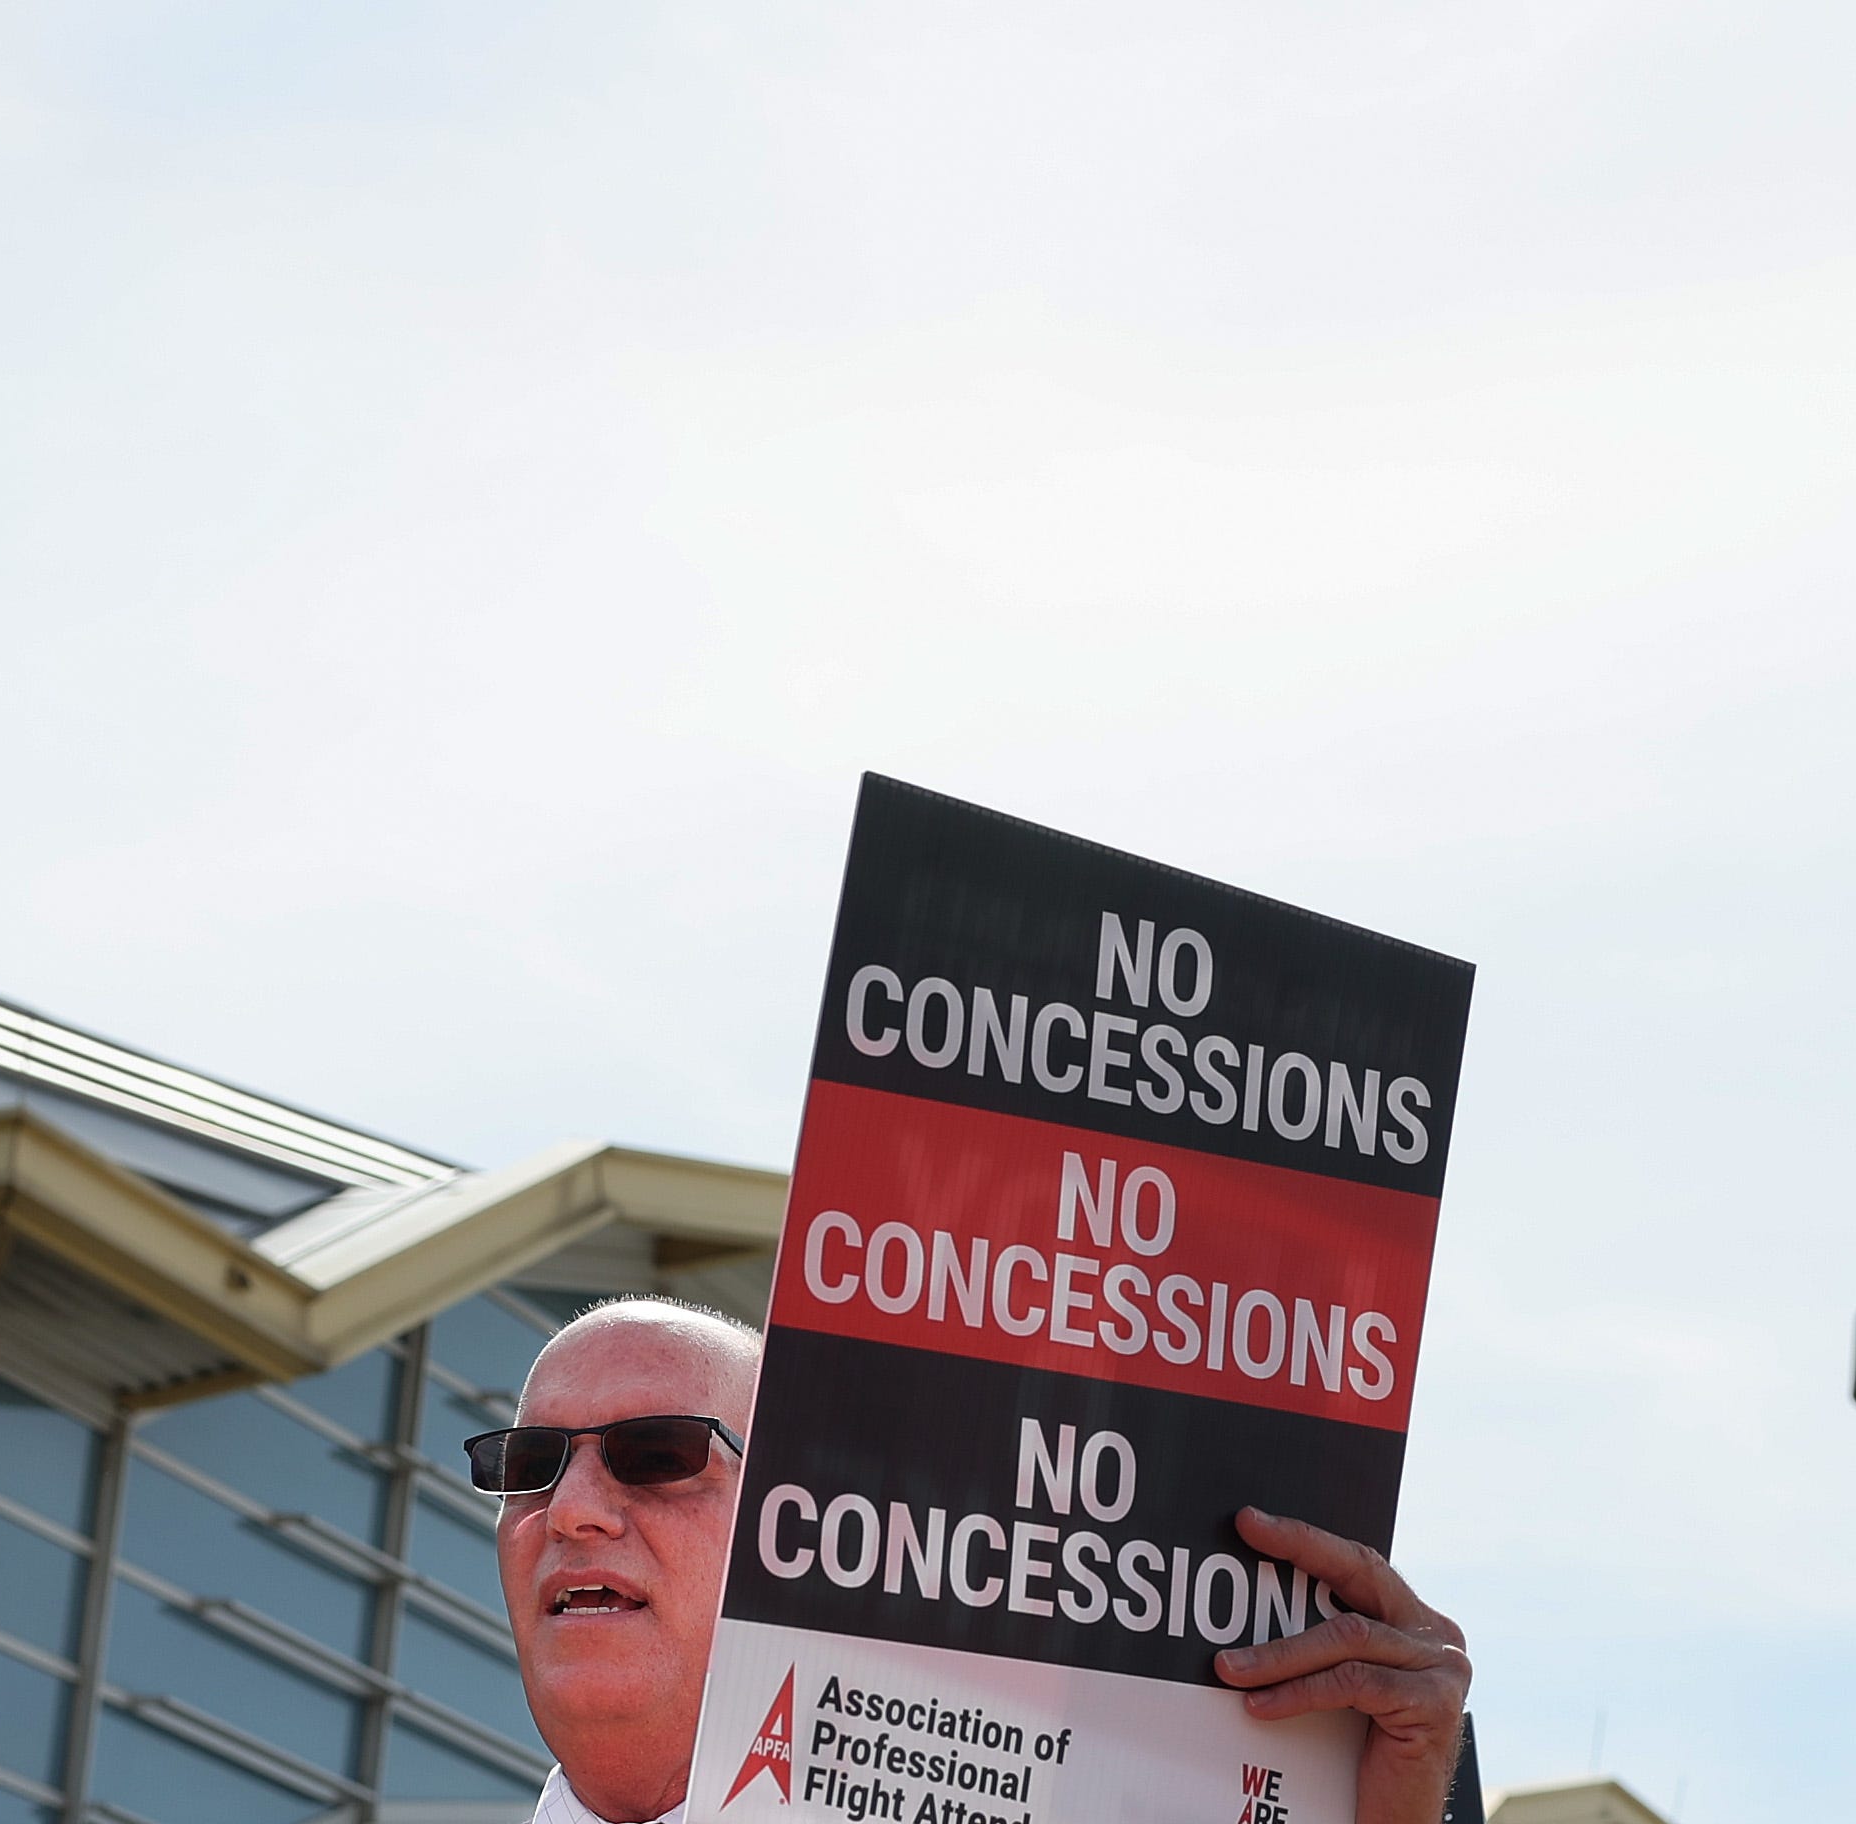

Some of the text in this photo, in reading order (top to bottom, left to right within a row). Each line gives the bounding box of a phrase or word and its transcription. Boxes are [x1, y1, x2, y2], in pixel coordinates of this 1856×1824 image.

[1096, 909, 1213, 1019] NO
[845, 963, 1432, 1165] CONCESSIONS
[1056, 1150, 1176, 1257] NO
[803, 1210, 1398, 1402] CONCESSIONS
[1014, 1417, 1136, 1523] NO
[751, 1735, 792, 1763] APFA
[810, 1720, 1032, 1803] Professional
[817, 1675, 1072, 1765] Association of
[803, 1766, 905, 1823] Flight
[1242, 1763, 1282, 1802] WE
